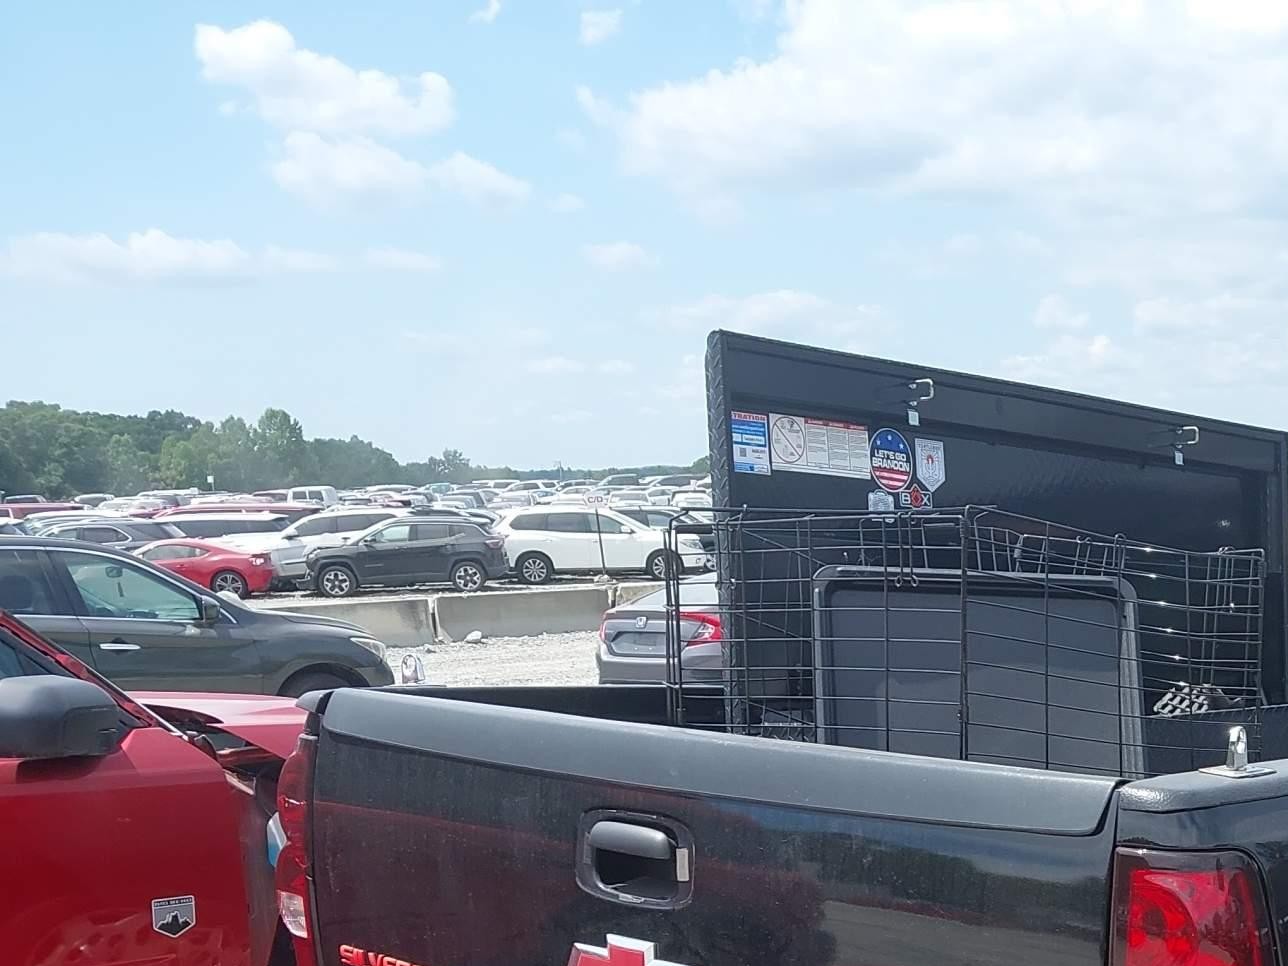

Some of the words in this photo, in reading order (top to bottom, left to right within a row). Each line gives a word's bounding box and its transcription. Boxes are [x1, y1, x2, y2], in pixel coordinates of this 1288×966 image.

[875, 449, 894, 459] LET'S
[895, 452, 907, 461] GO
[872, 457, 910, 472] BRANDON
